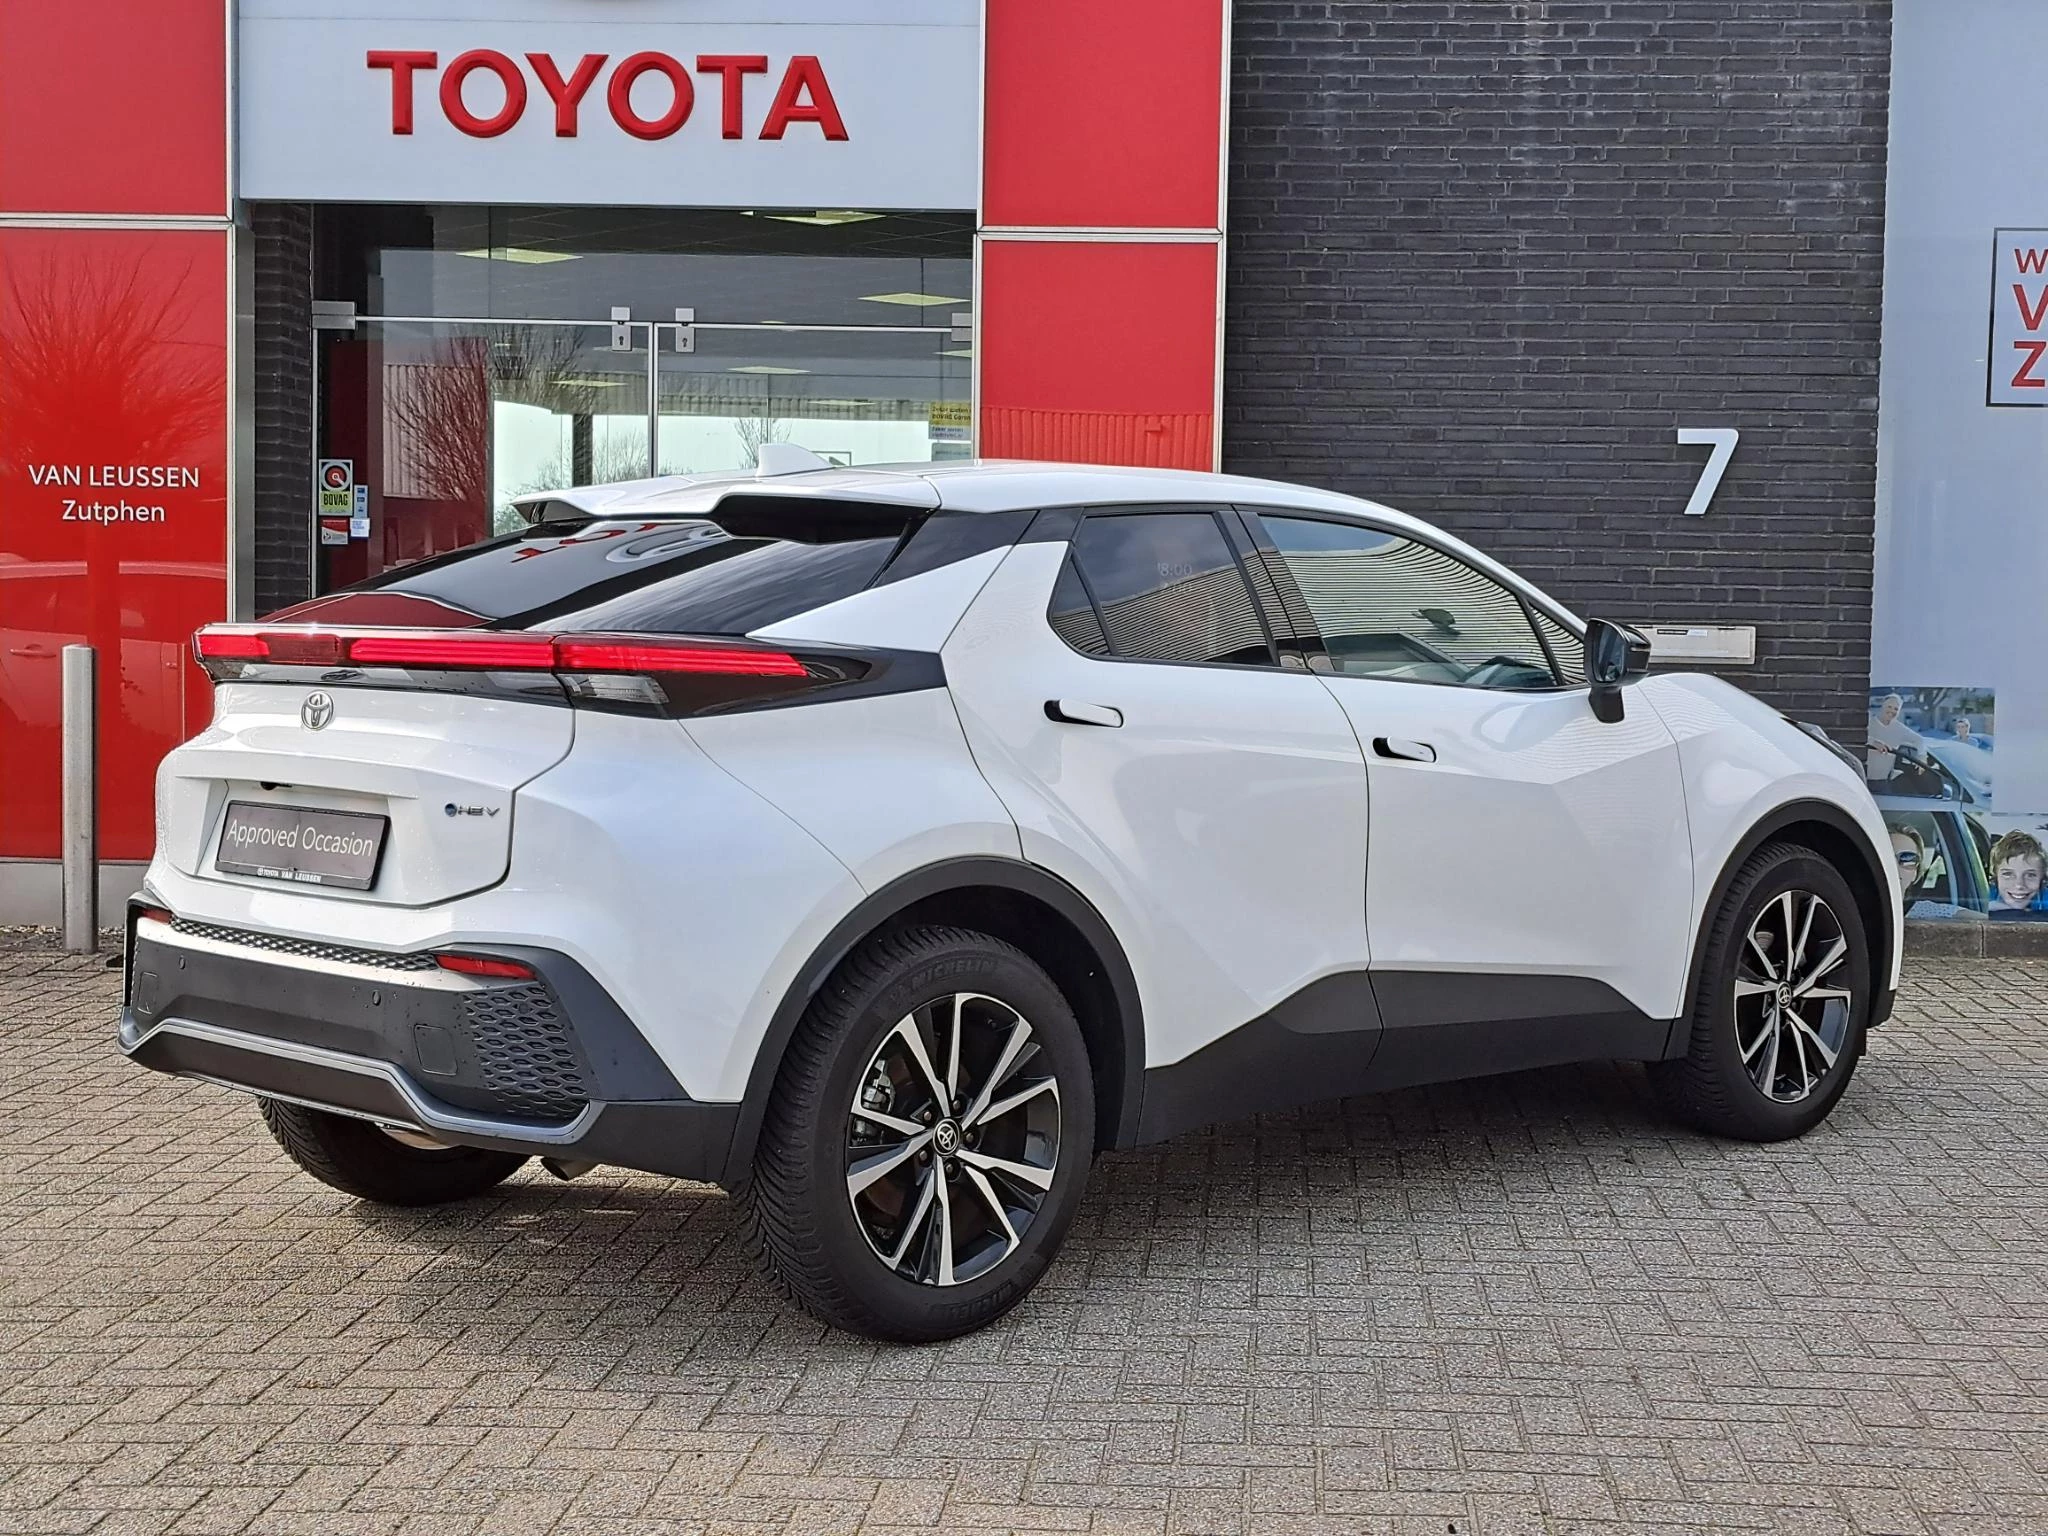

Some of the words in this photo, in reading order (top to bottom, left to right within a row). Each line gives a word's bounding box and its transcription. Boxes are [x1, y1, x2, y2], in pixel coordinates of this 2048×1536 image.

[367, 48, 849, 141] TOYOTA
[28, 464, 81, 486] VAN
[89, 465, 199, 488] LEUSSEN
[1677, 428, 1739, 515] 7
[62, 499, 165, 526] Zutphen
[323, 493, 348, 506] BOVAG
[226, 818, 300, 848] Approved
[302, 826, 373, 857] Occasion
